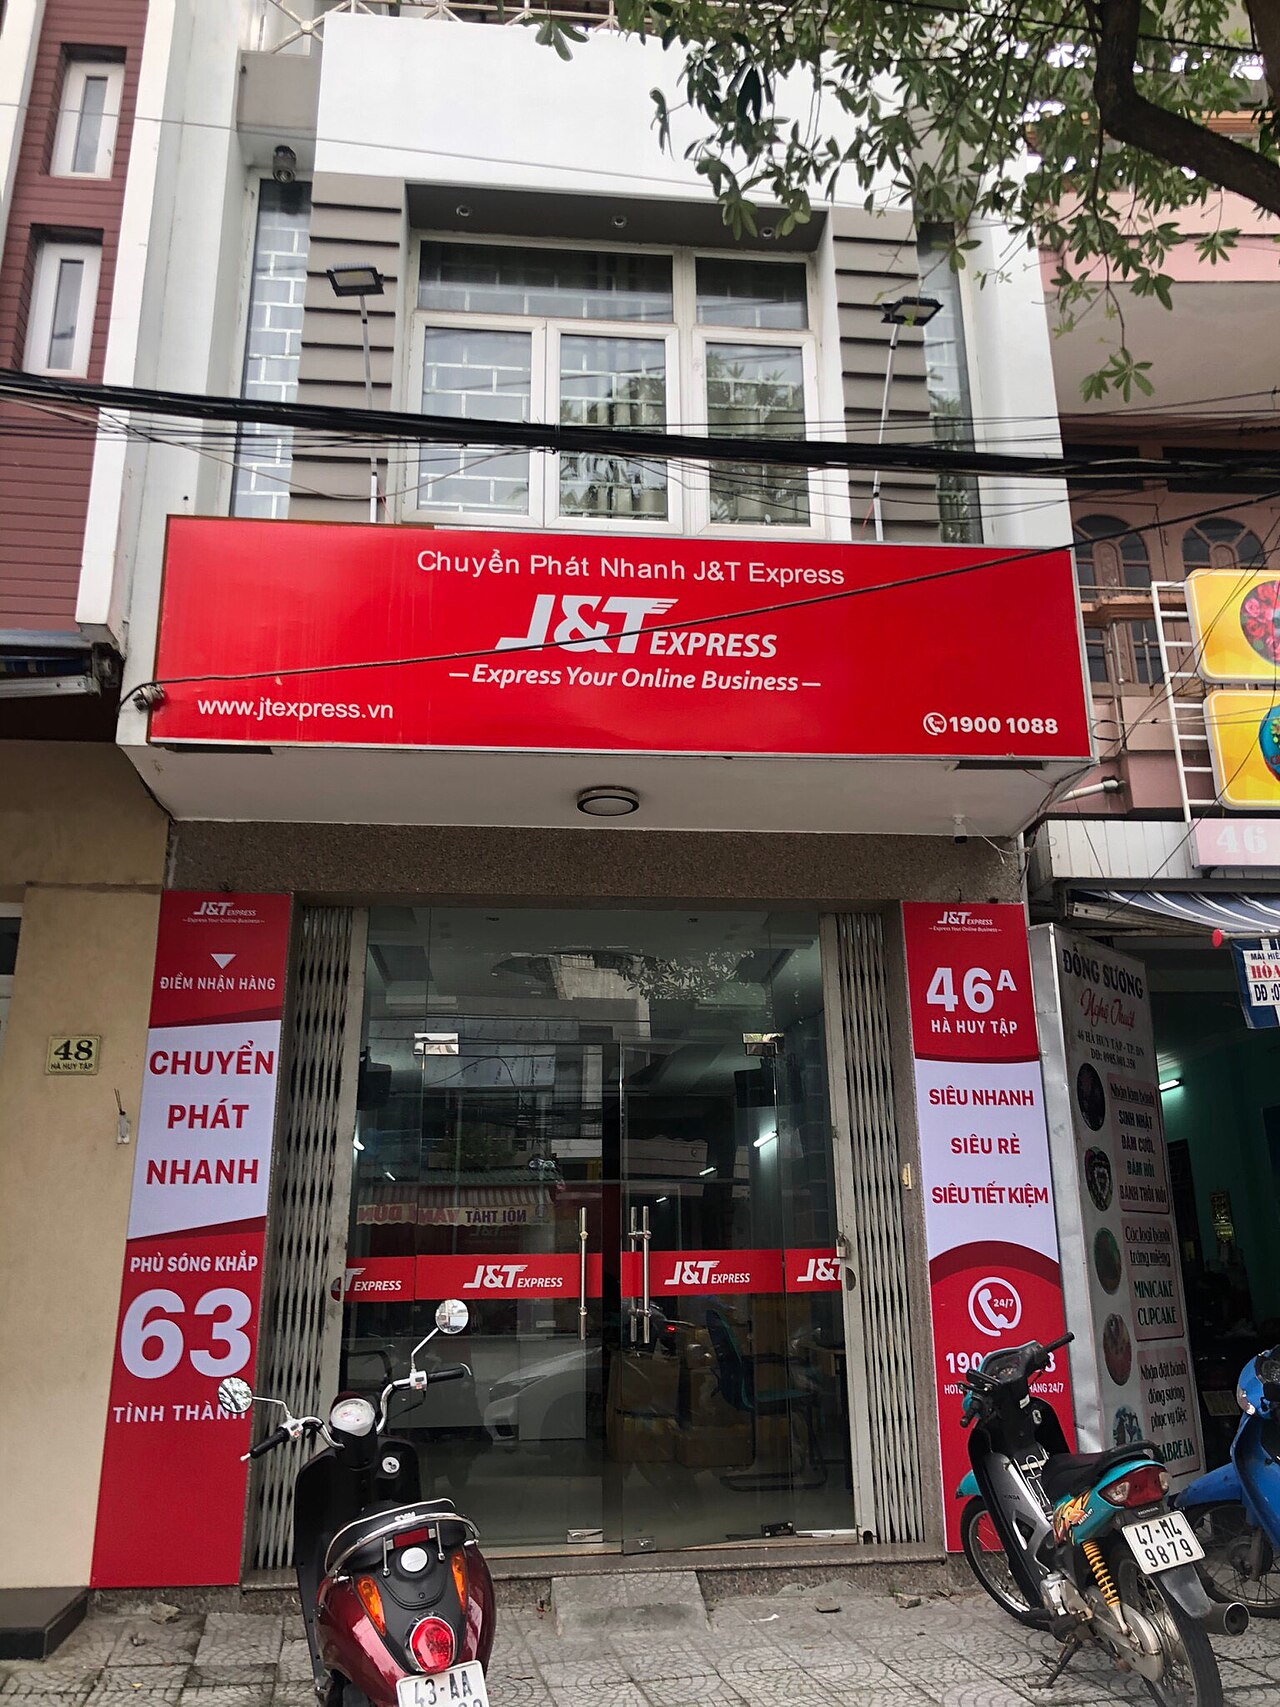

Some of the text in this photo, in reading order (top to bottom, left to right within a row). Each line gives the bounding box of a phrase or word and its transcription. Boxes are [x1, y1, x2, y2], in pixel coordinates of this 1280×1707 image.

[417, 549, 845, 587] Chuyển Phát Nhanh J&T Express
[495, 594, 777, 658] J&T EXPRESS
[472, 663, 798, 692] Express Your Online Business
[197, 696, 393, 721] www.jtexpress.vn
[949, 716, 1059, 734] 1900 1088
[1215, 825, 1268, 854] 46
[193, 901, 234, 916] J&T
[937, 911, 993, 926] J&T EXPRESS
[197, 974, 235, 992] NHẬN
[239, 975, 276, 990] HÀNG
[931, 1017, 1018, 1037] HÀ HUY TẬP
[54, 1040, 93, 1061] 48
[149, 1040, 275, 1075] CHUYỂN
[928, 1085, 1034, 1106] SIÊU NHANH
[167, 1098, 250, 1129] PHÁT
[951, 1132, 1021, 1154] SIÊU RẺ
[146, 1159, 259, 1185] NHANH
[931, 1181, 1049, 1208] SIÊU TIẾT KIỆM
[167, 1252, 211, 1272] SÓNG
[214, 1249, 258, 1272] KHẮP
[463, 1264, 563, 1288] J&T EXPRESS
[664, 1260, 750, 1285] J&T EXPRESS
[354, 1280, 401, 1291] EXPRESS
[1134, 1280, 1174, 1298] MINICAKE
[993, 1298, 1014, 1308] 24/7
[1137, 1306, 1177, 1326] CUPCAKE
[120, 1287, 252, 1380] 63
[1049, 1382, 1064, 1394] 24/7
[1138, 1506, 1158, 1516] HONDA
[1144, 1538, 1194, 1568] 9879
[414, 1670, 473, 1707] 43-AA
